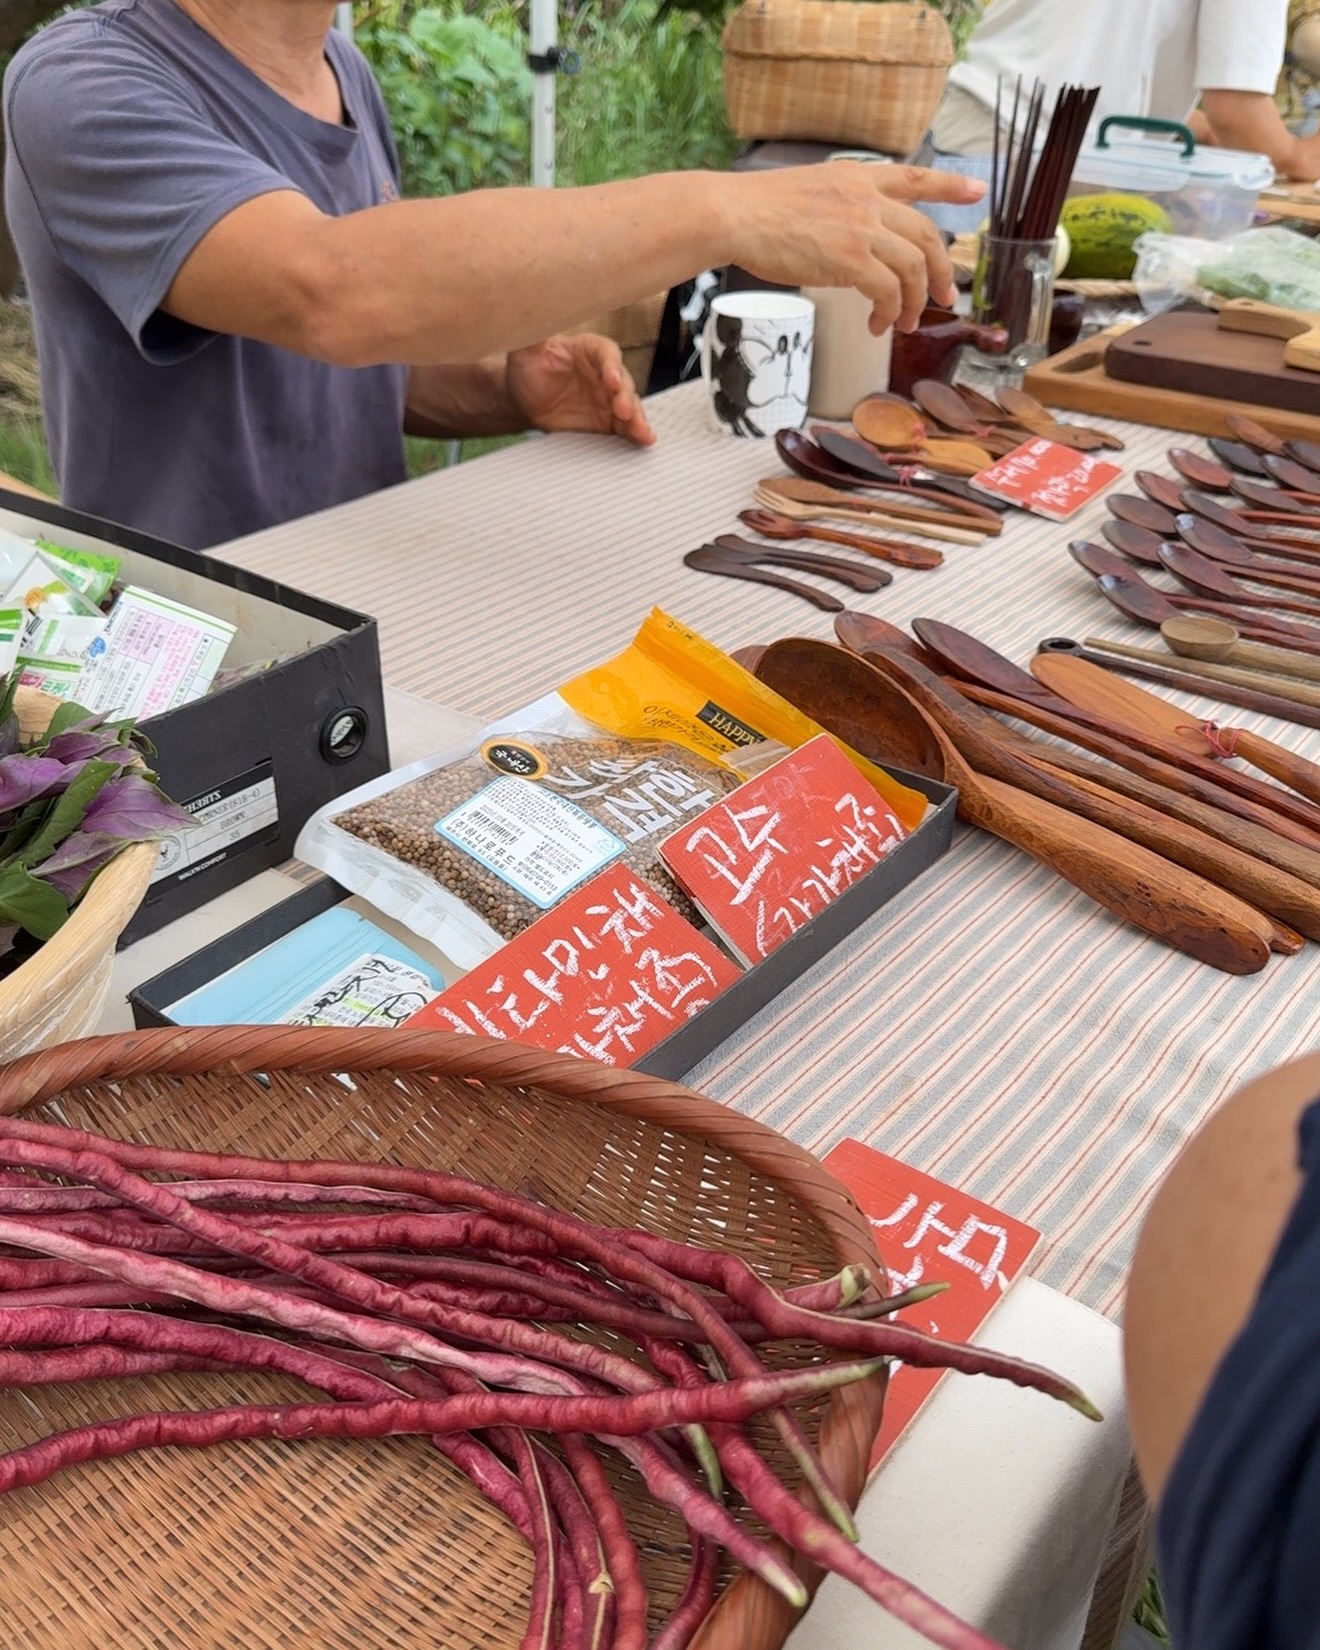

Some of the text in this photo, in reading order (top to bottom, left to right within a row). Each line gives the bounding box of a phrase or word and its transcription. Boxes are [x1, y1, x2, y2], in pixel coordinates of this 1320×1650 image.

[220, 811, 246, 830] BROWN
[230, 830, 241, 841] 35
[681, 804, 789, 906] 고수
